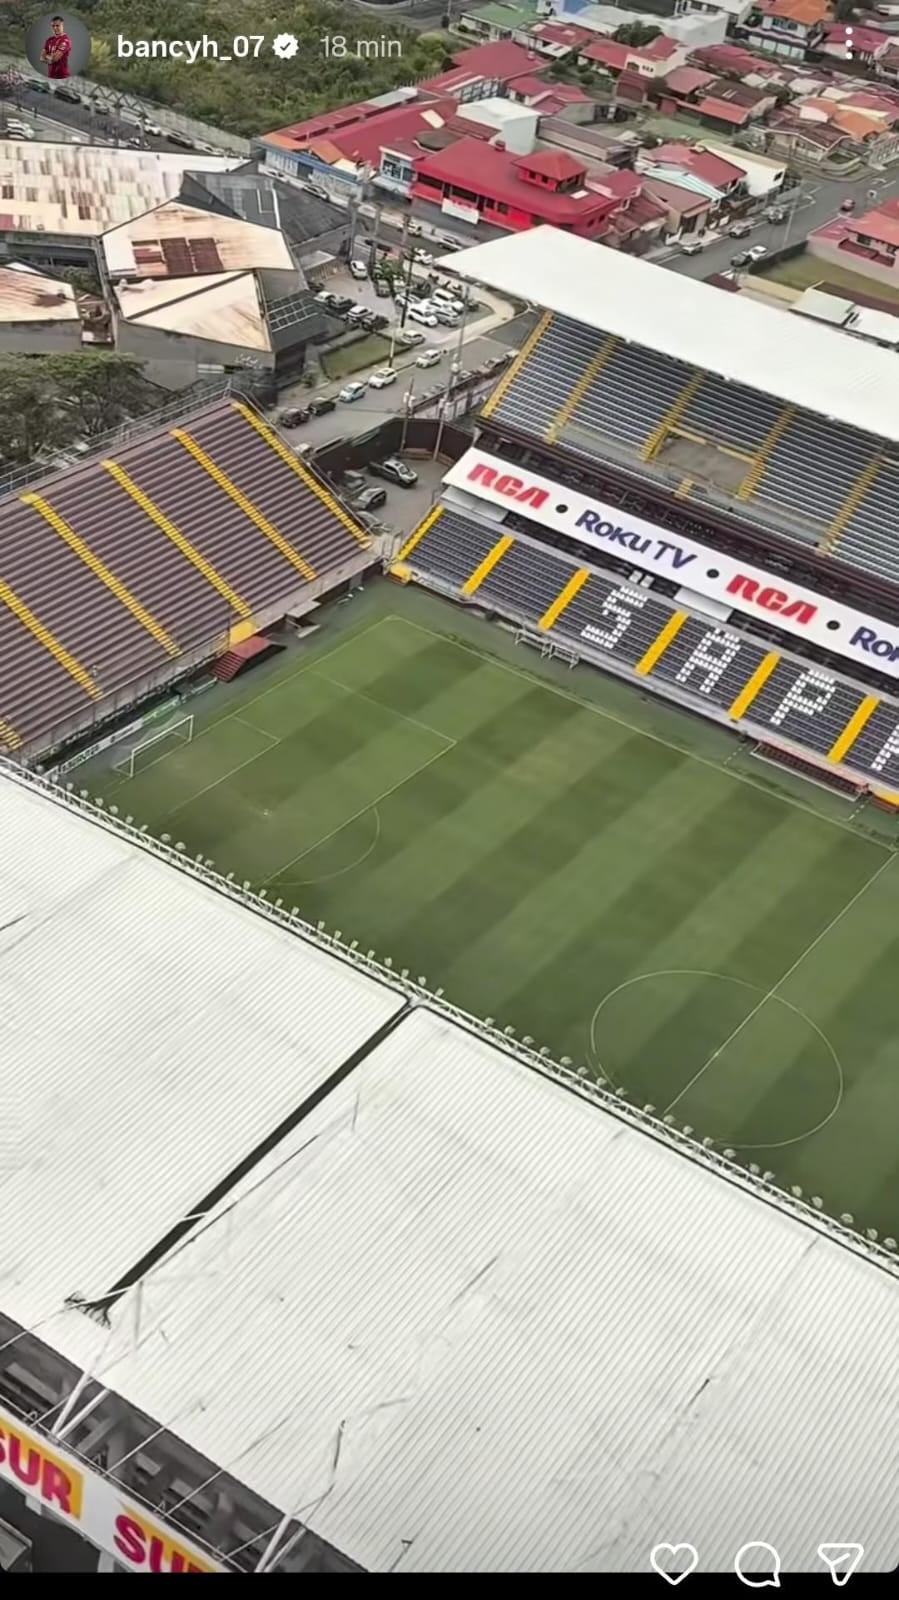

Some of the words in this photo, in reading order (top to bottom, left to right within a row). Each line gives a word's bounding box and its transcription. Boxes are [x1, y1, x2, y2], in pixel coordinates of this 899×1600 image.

[467, 463, 550, 510] RCA
[658, 540, 698, 569] TV
[726, 574, 818, 625] RCA
[0, 1429, 72, 1515] UR
[113, 1514, 204, 1574] SU
